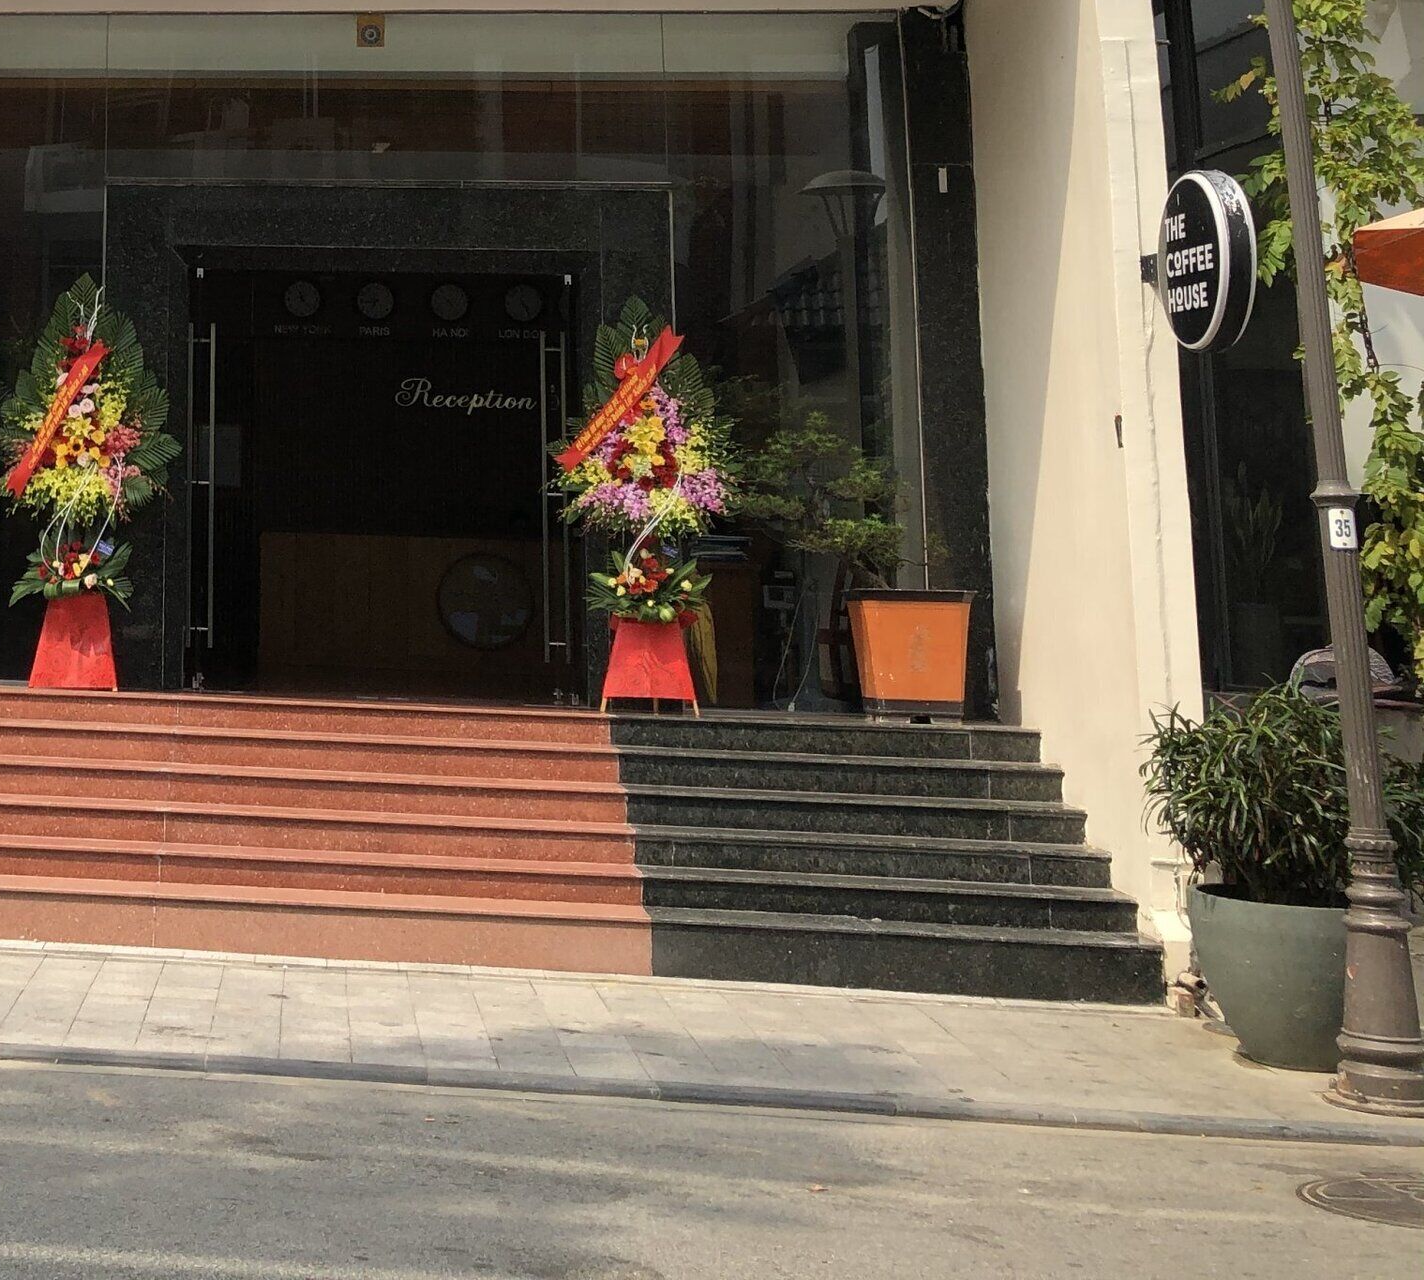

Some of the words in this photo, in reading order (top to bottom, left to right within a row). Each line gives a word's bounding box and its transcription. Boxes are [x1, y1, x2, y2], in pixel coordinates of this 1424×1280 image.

[1164, 213, 1187, 243] THE
[1165, 243, 1214, 279] COFFEE
[1167, 281, 1210, 314] HOUSE
[359, 326, 391, 336] PARIS
[395, 377, 537, 415] Reception
[1335, 518, 1351, 538] 35
